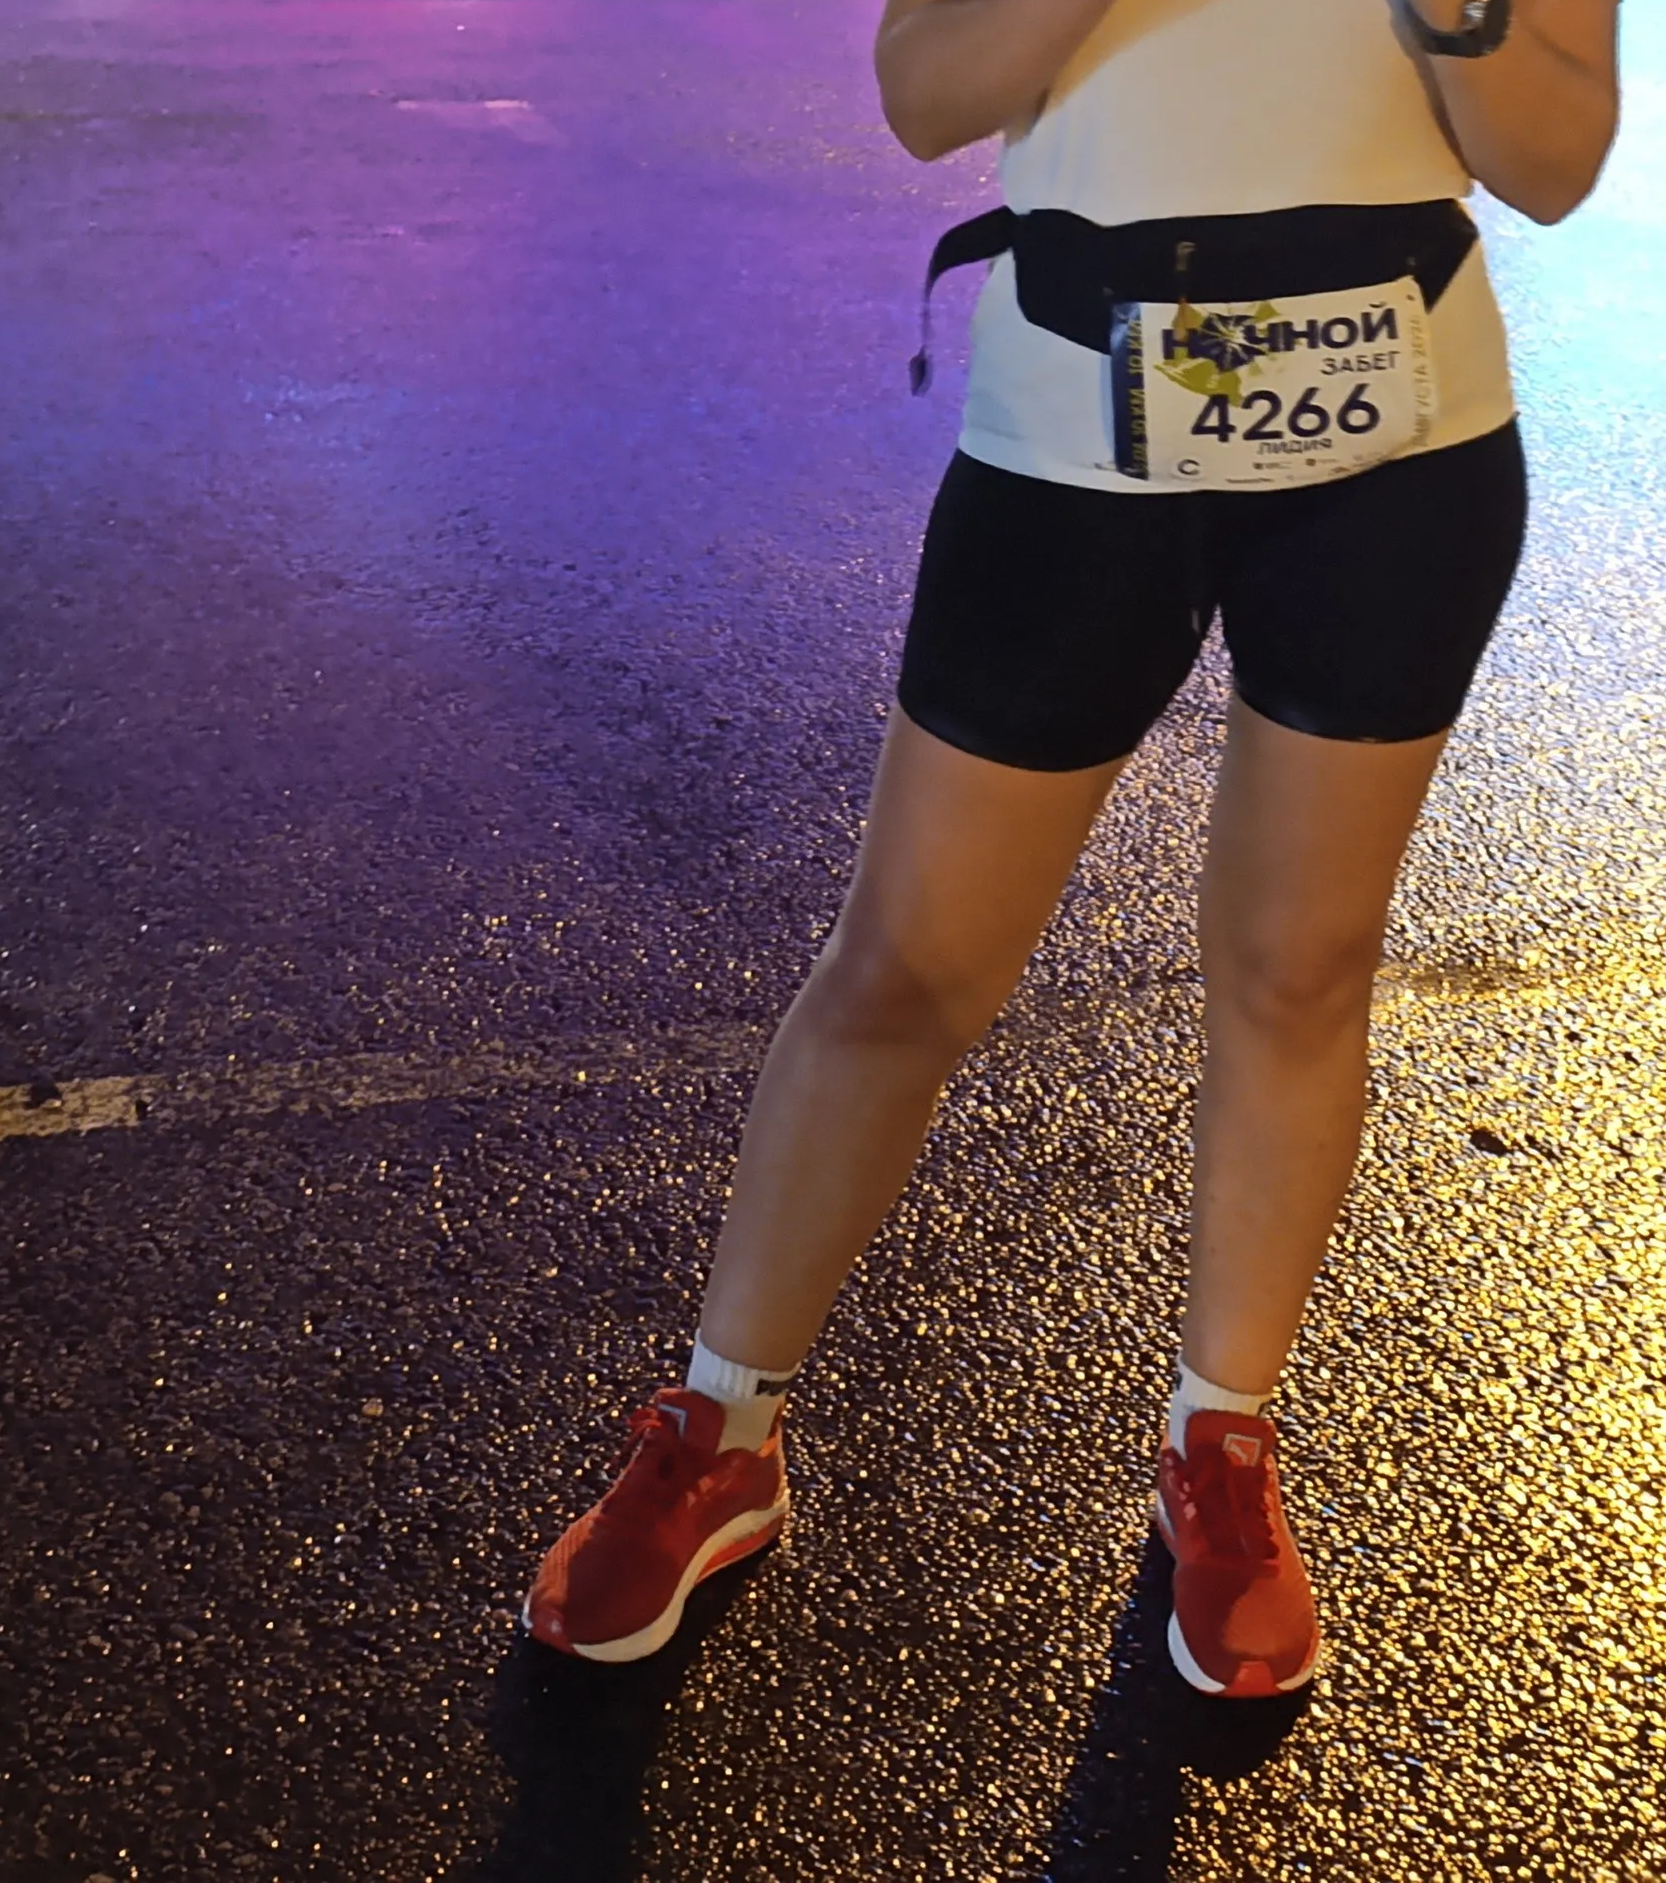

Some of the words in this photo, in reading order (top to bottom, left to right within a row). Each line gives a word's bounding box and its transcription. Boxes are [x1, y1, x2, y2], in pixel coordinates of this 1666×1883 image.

[1319, 351, 1400, 376] ЗАБЕГ
[1190, 383, 1381, 443] 4266
[1256, 437, 1334, 455] ЛИДИЯ
